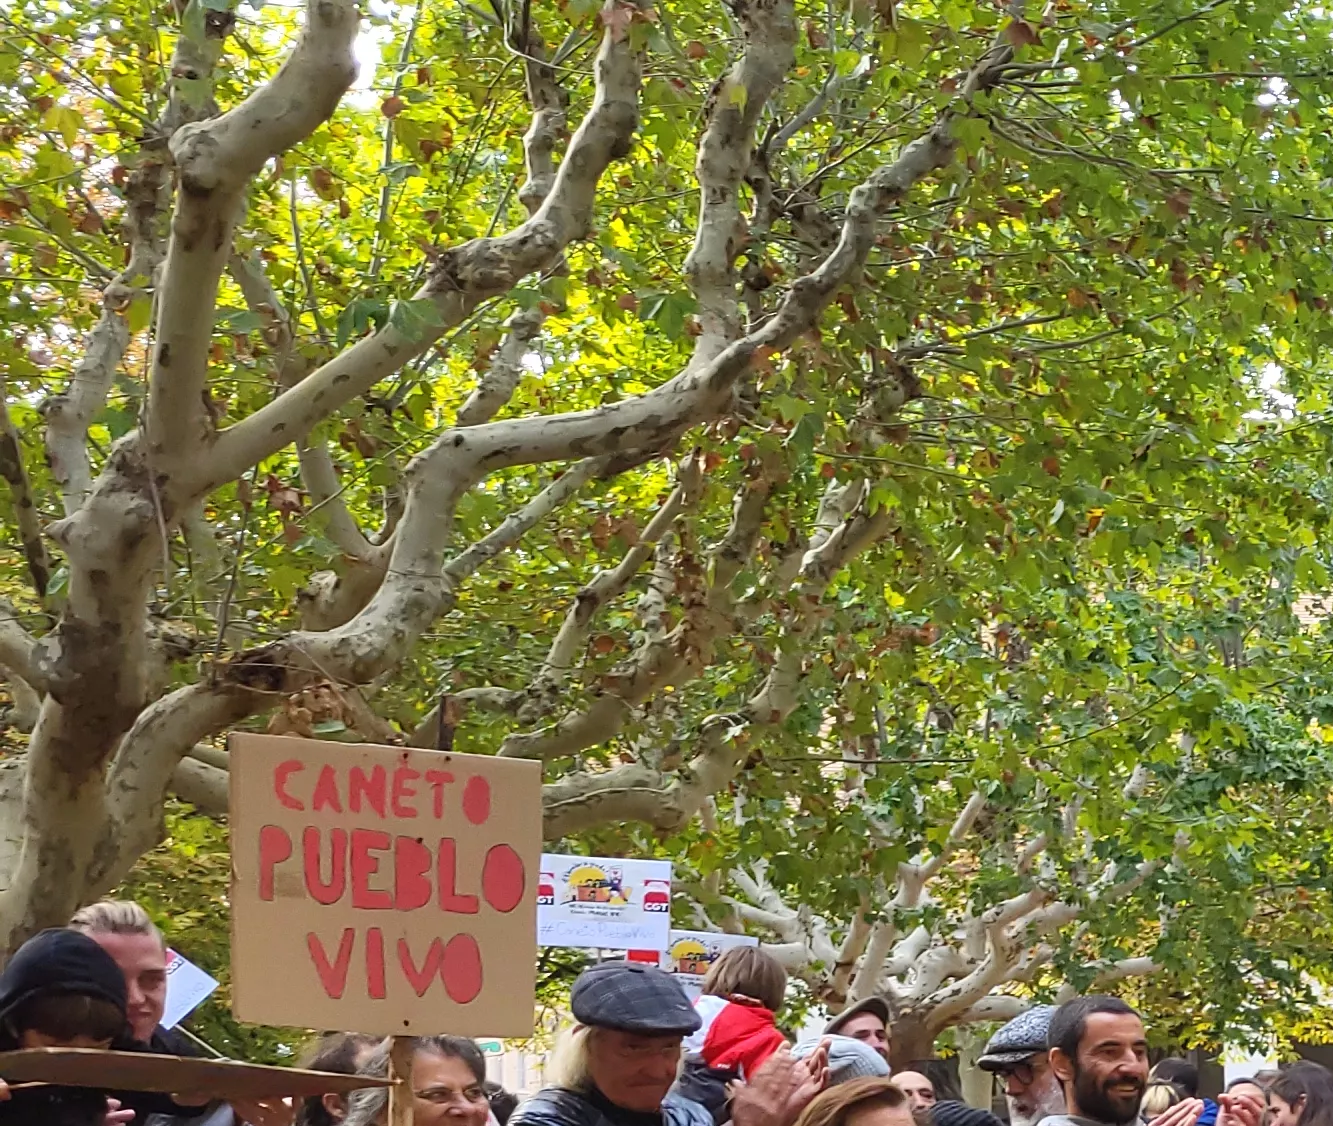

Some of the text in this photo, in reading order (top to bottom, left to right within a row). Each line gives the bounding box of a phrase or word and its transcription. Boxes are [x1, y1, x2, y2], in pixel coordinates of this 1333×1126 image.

[259, 824, 525, 915] PUEBLO
[644, 902, 669, 912] CGT
[307, 926, 483, 1004] VIVO
